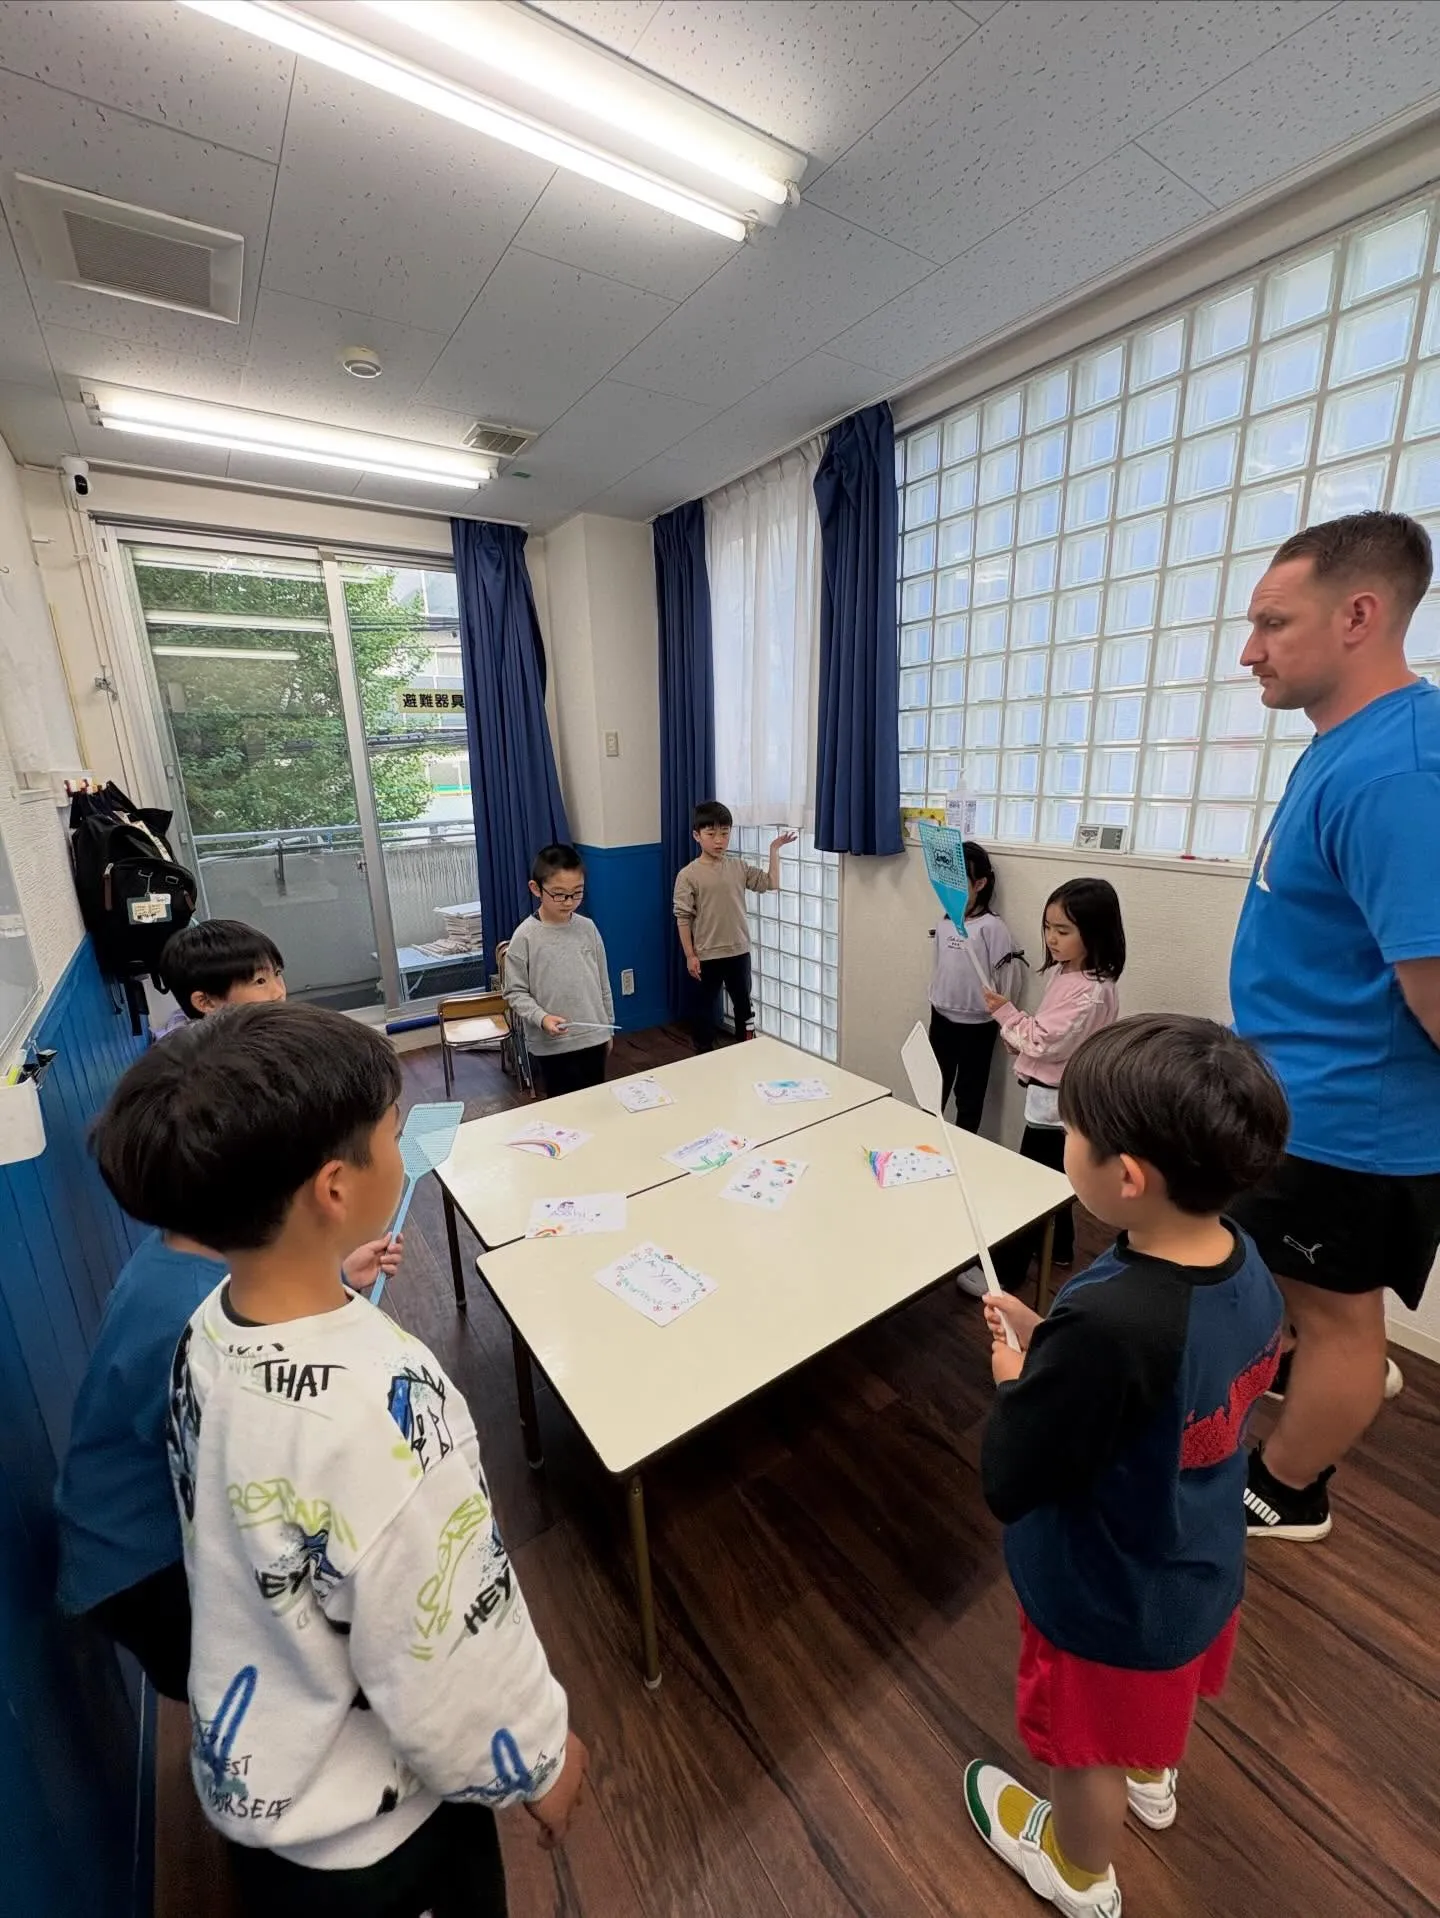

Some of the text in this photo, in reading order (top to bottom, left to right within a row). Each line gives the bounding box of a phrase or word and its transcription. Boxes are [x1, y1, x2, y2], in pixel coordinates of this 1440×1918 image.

[402, 693, 465, 708] 避難器具
[253, 1359, 349, 1402] THAT
[1243, 1487, 1281, 1526] UMA
[464, 1567, 511, 1635] HEY
[223, 1754, 252, 1776] EST
